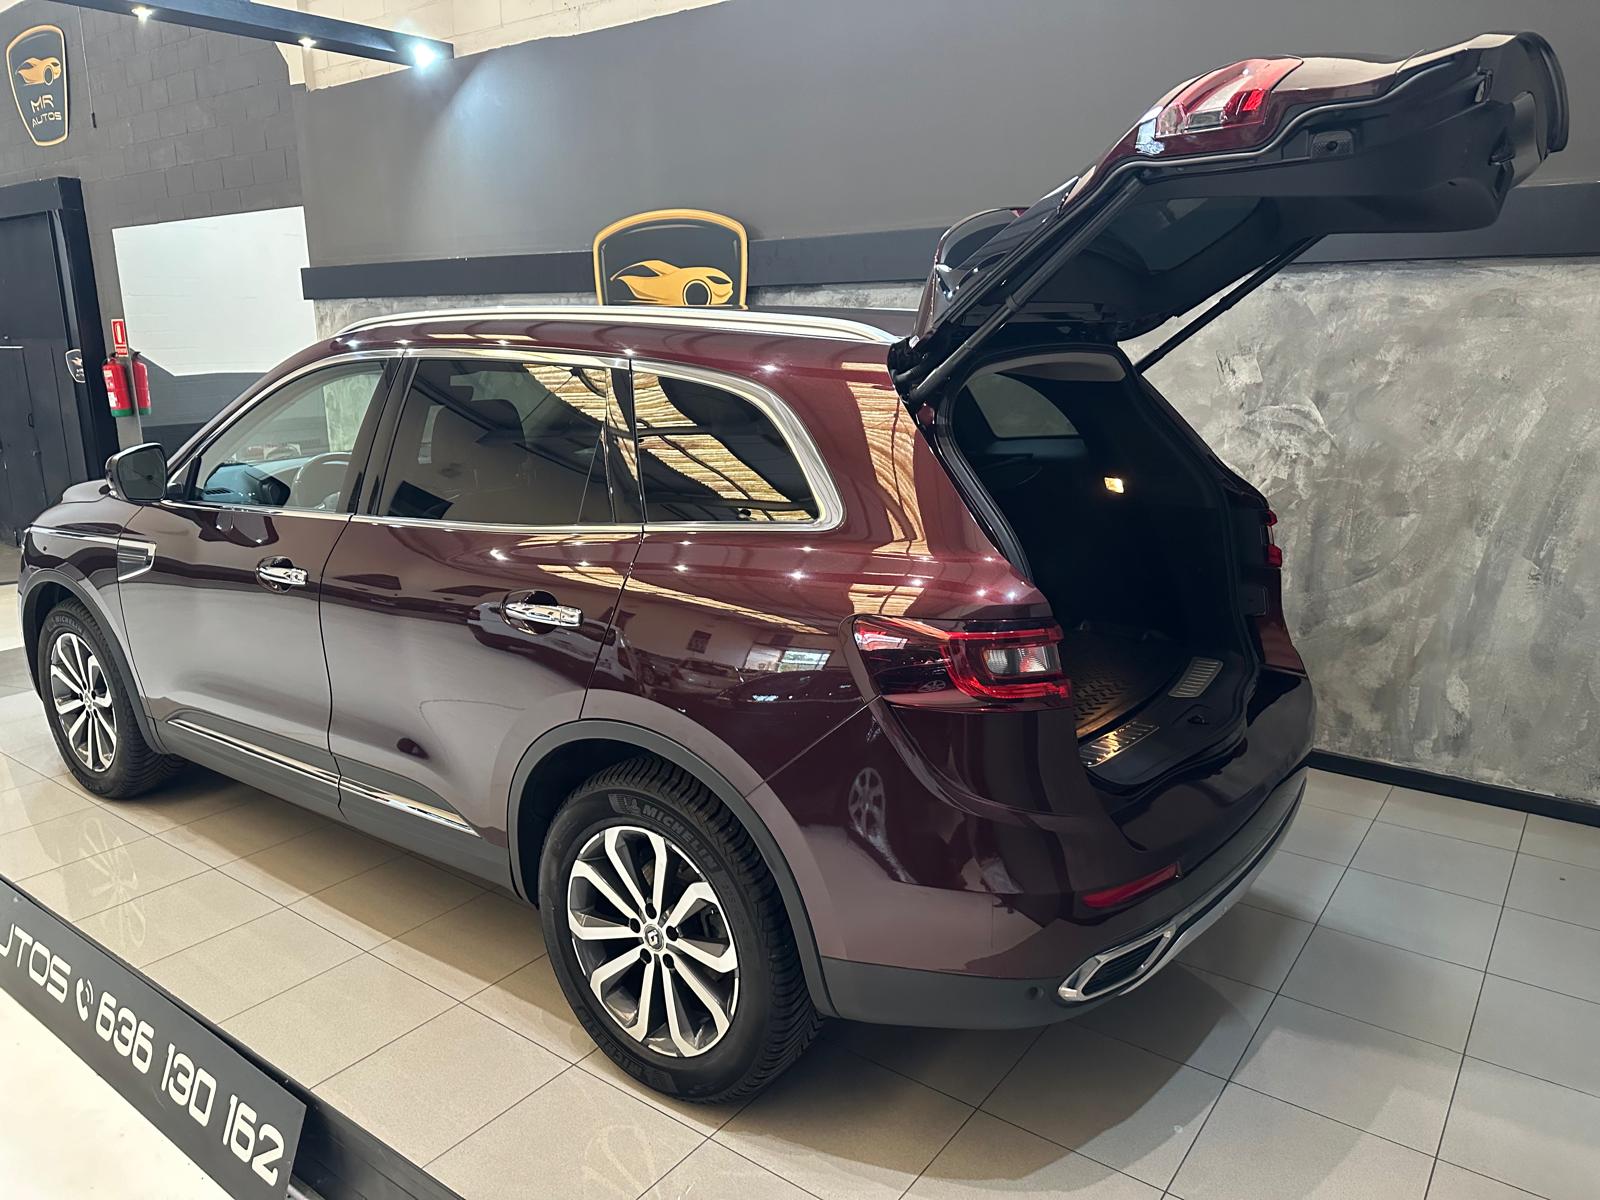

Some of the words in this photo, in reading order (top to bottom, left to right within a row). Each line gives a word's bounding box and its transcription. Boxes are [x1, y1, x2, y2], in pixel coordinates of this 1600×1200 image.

[32, 111, 62, 128] AUTOS
[642, 804, 718, 869] MICHELIN
[95, 991, 154, 1074] 636
[161, 1043, 216, 1127] 130
[222, 1094, 285, 1187] 162
